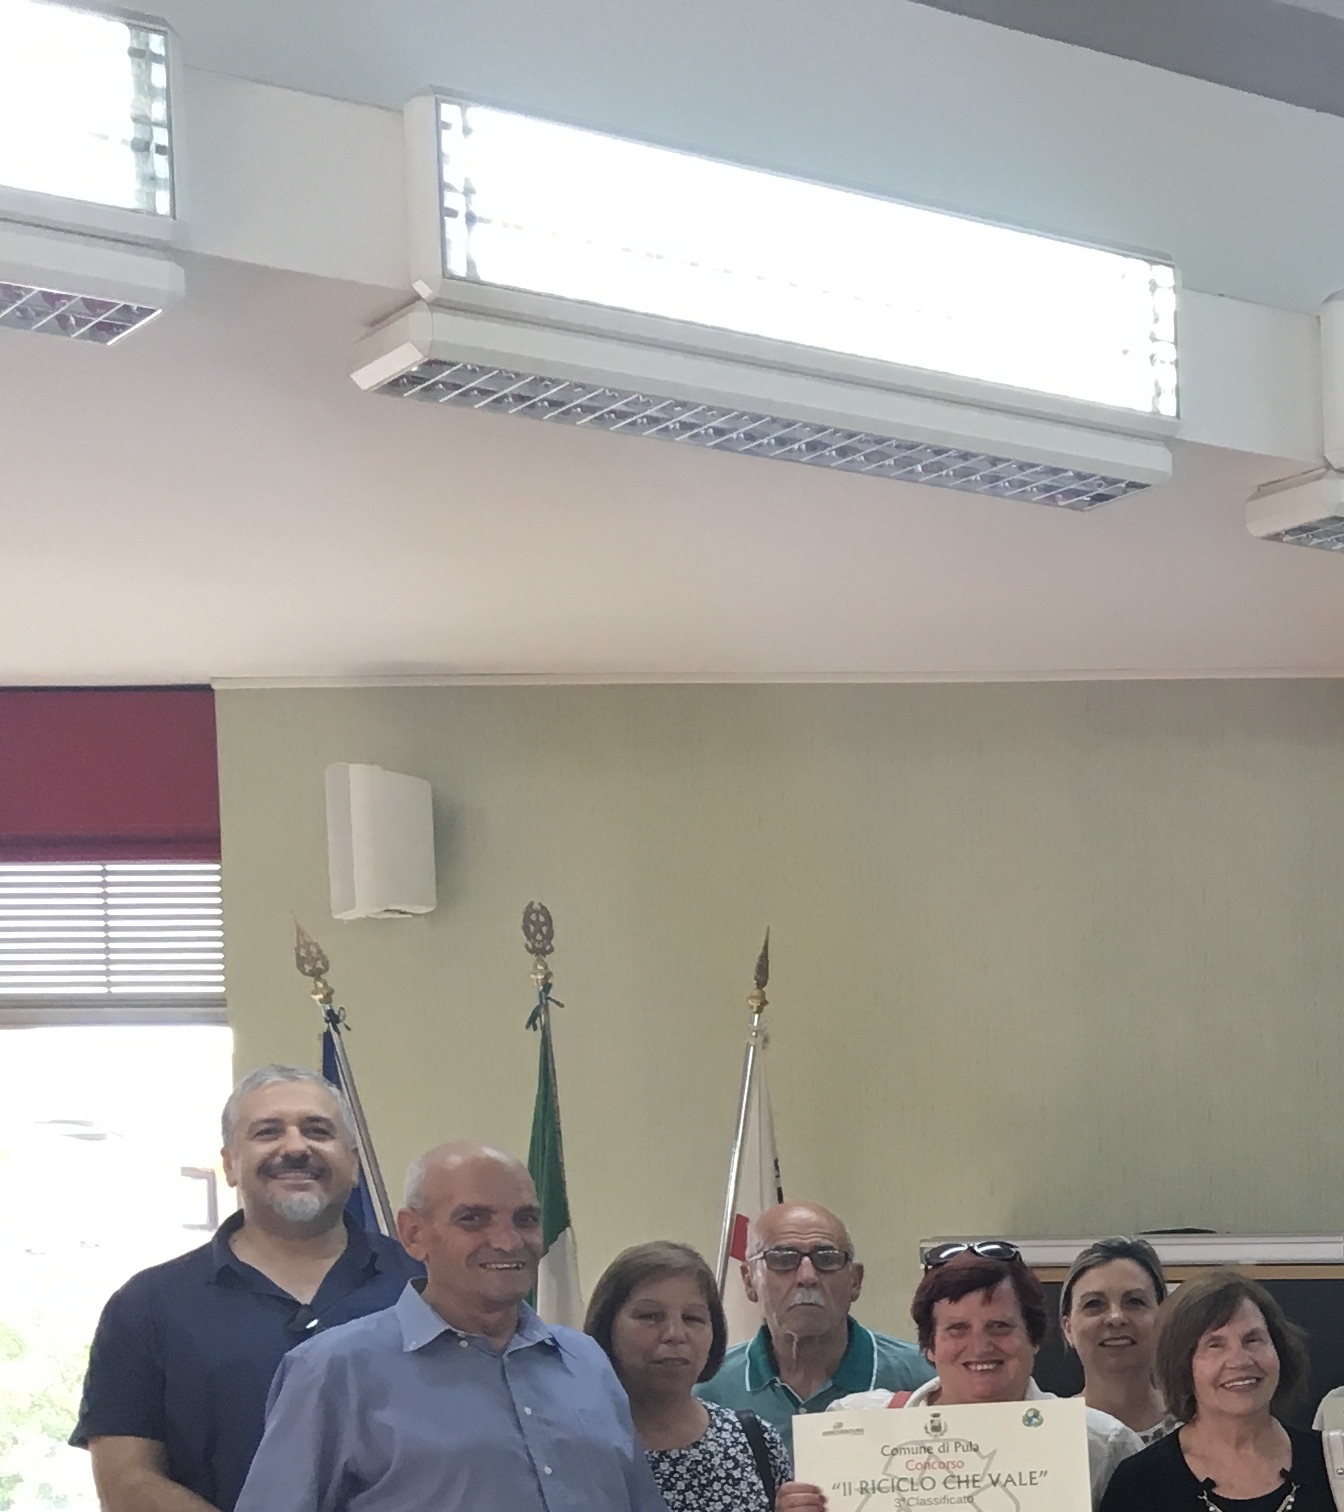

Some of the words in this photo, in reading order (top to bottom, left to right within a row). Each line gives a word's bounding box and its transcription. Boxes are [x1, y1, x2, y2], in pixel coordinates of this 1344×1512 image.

[881, 1443, 934, 1457] Comune
[938, 1442, 950, 1453] di
[954, 1441, 980, 1453] Pula
[905, 1459, 965, 1472] Concorso
[859, 1476, 937, 1495] RICICLO
[942, 1472, 981, 1489] CHE
[988, 1470, 1048, 1488] VALE”
